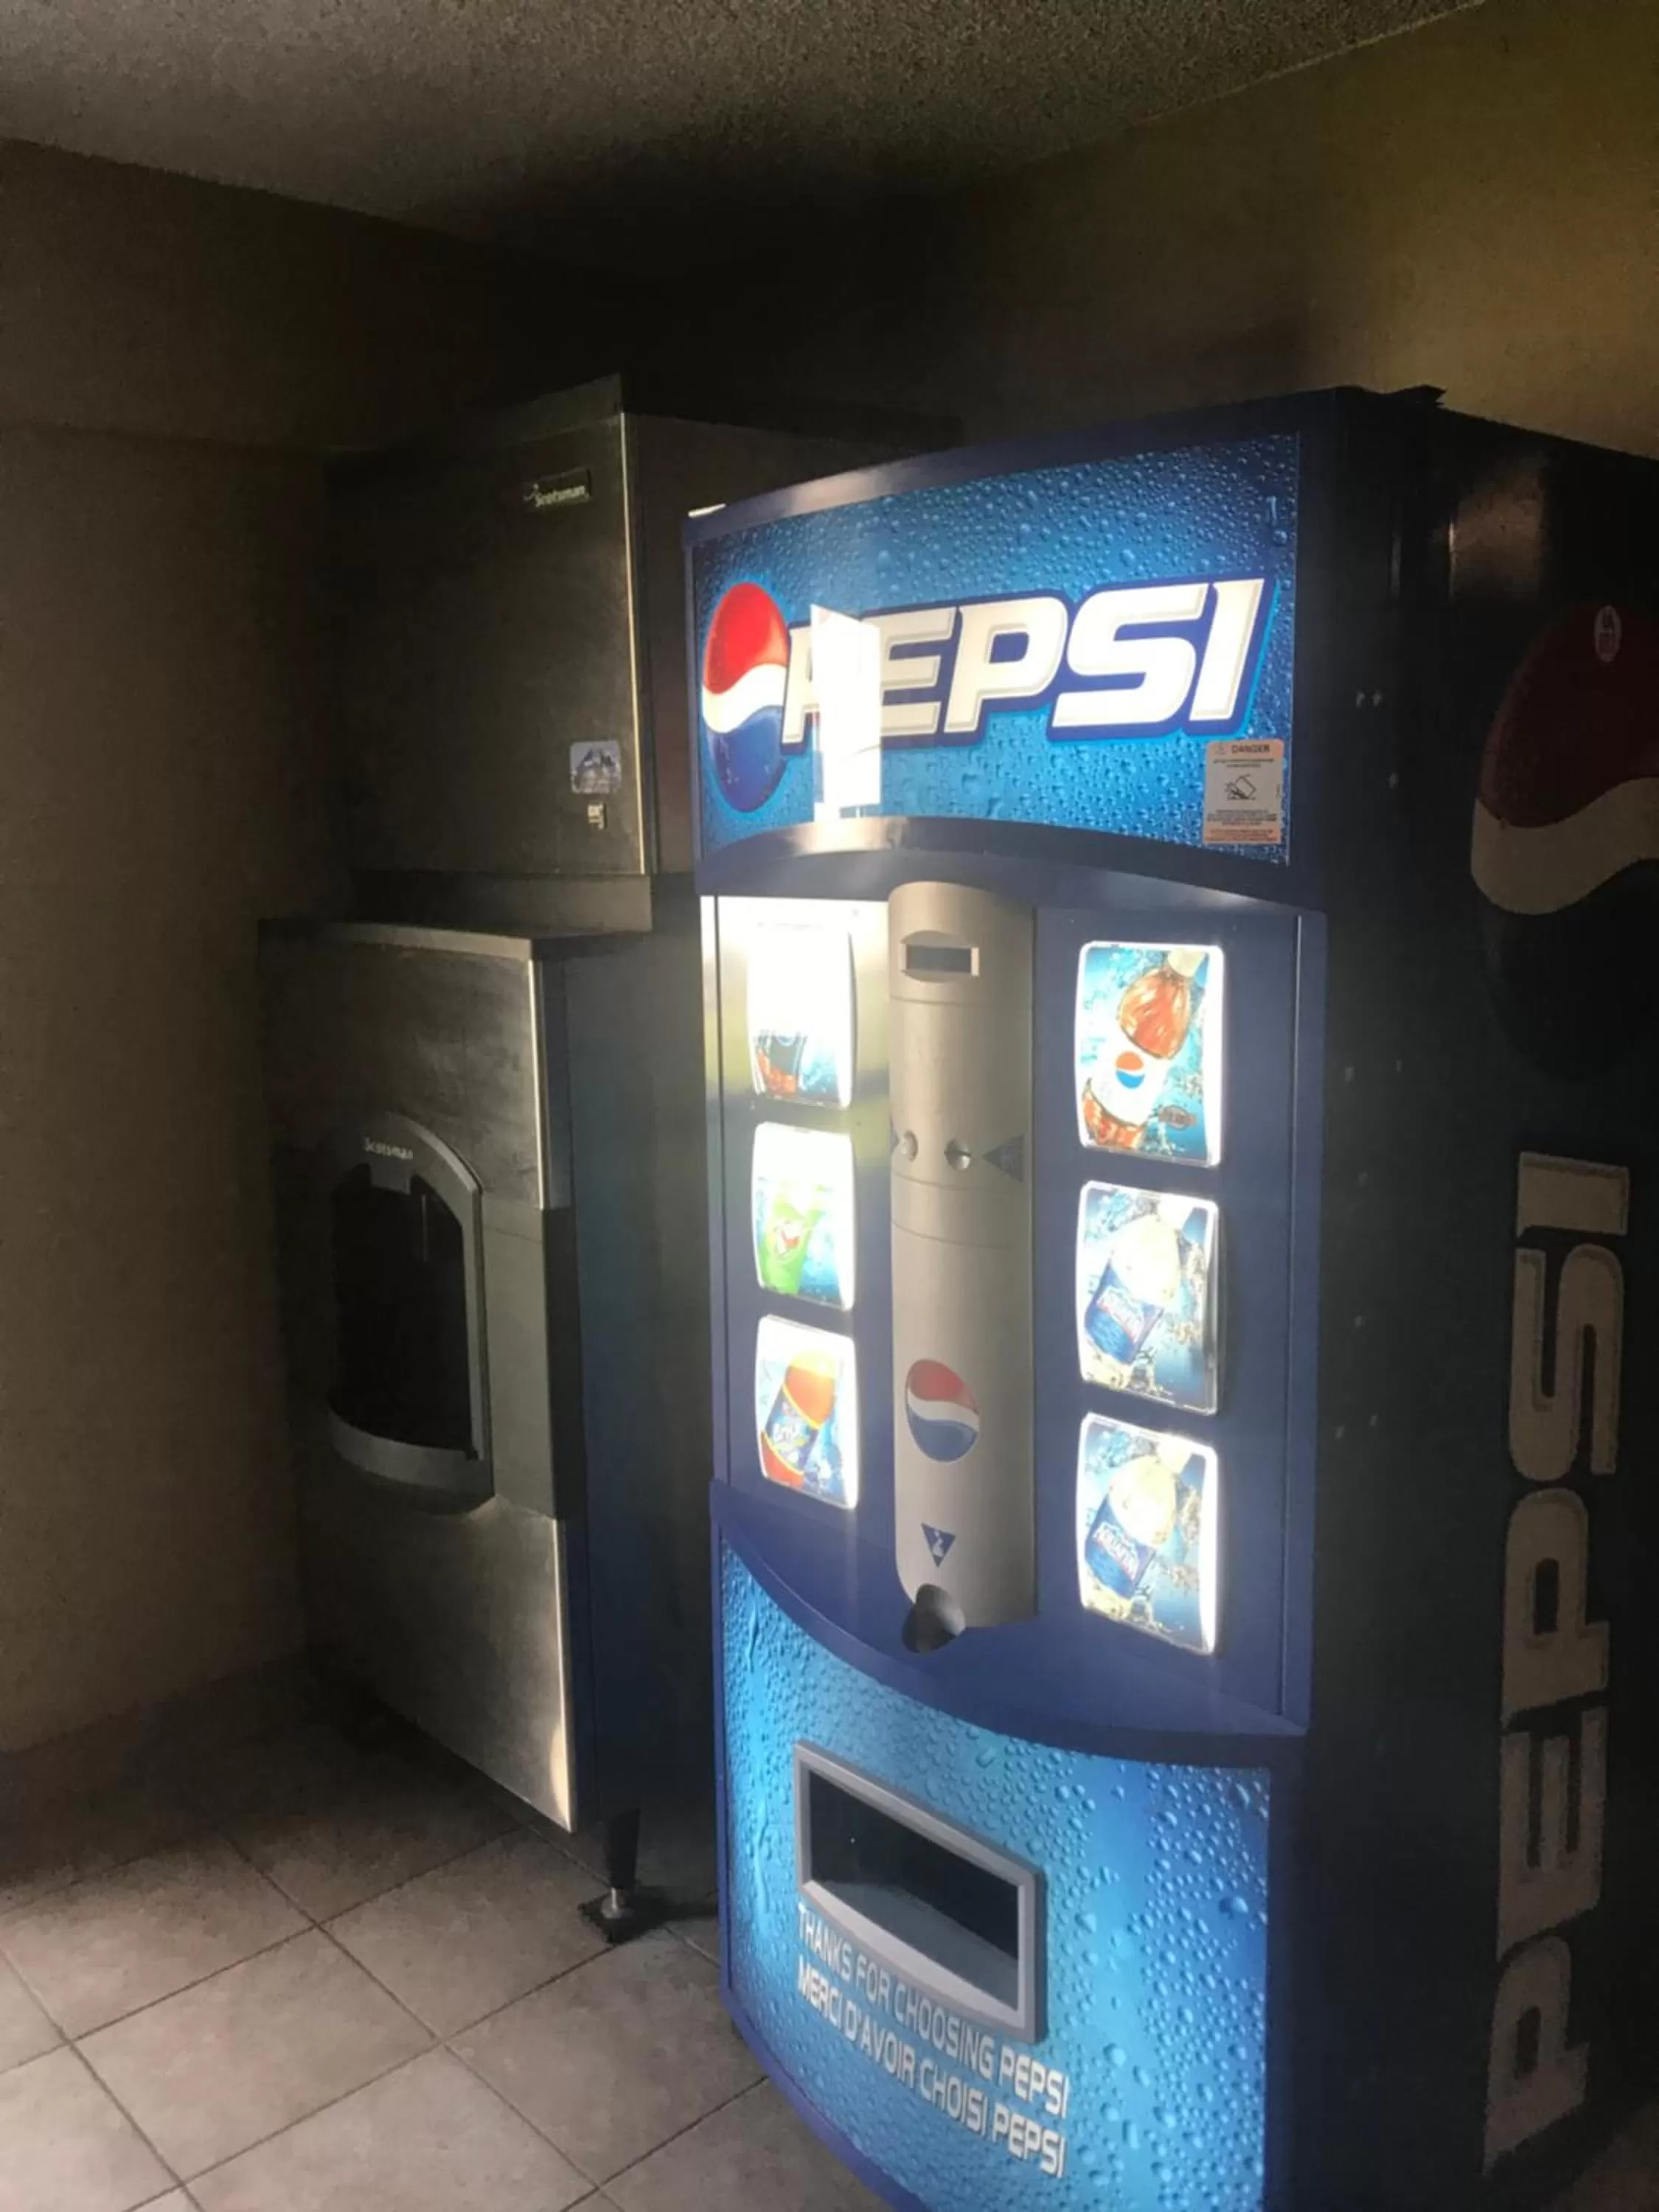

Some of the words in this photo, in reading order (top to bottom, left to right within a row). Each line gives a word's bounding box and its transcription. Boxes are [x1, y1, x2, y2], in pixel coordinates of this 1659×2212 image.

[1482, 1150, 1629, 2175] PEPSI
[798, 1902, 852, 1982] THANKS
[855, 1954, 892, 2014] FOR
[894, 1979, 995, 2081] CHOOSING
[998, 2045, 1069, 2120] PEPSI
[798, 1955, 843, 2029] MERCI
[845, 1999, 915, 2089] D'AVOIR
[919, 2058, 989, 2136] CHOISI
[992, 2104, 1066, 2180] PEPSI
